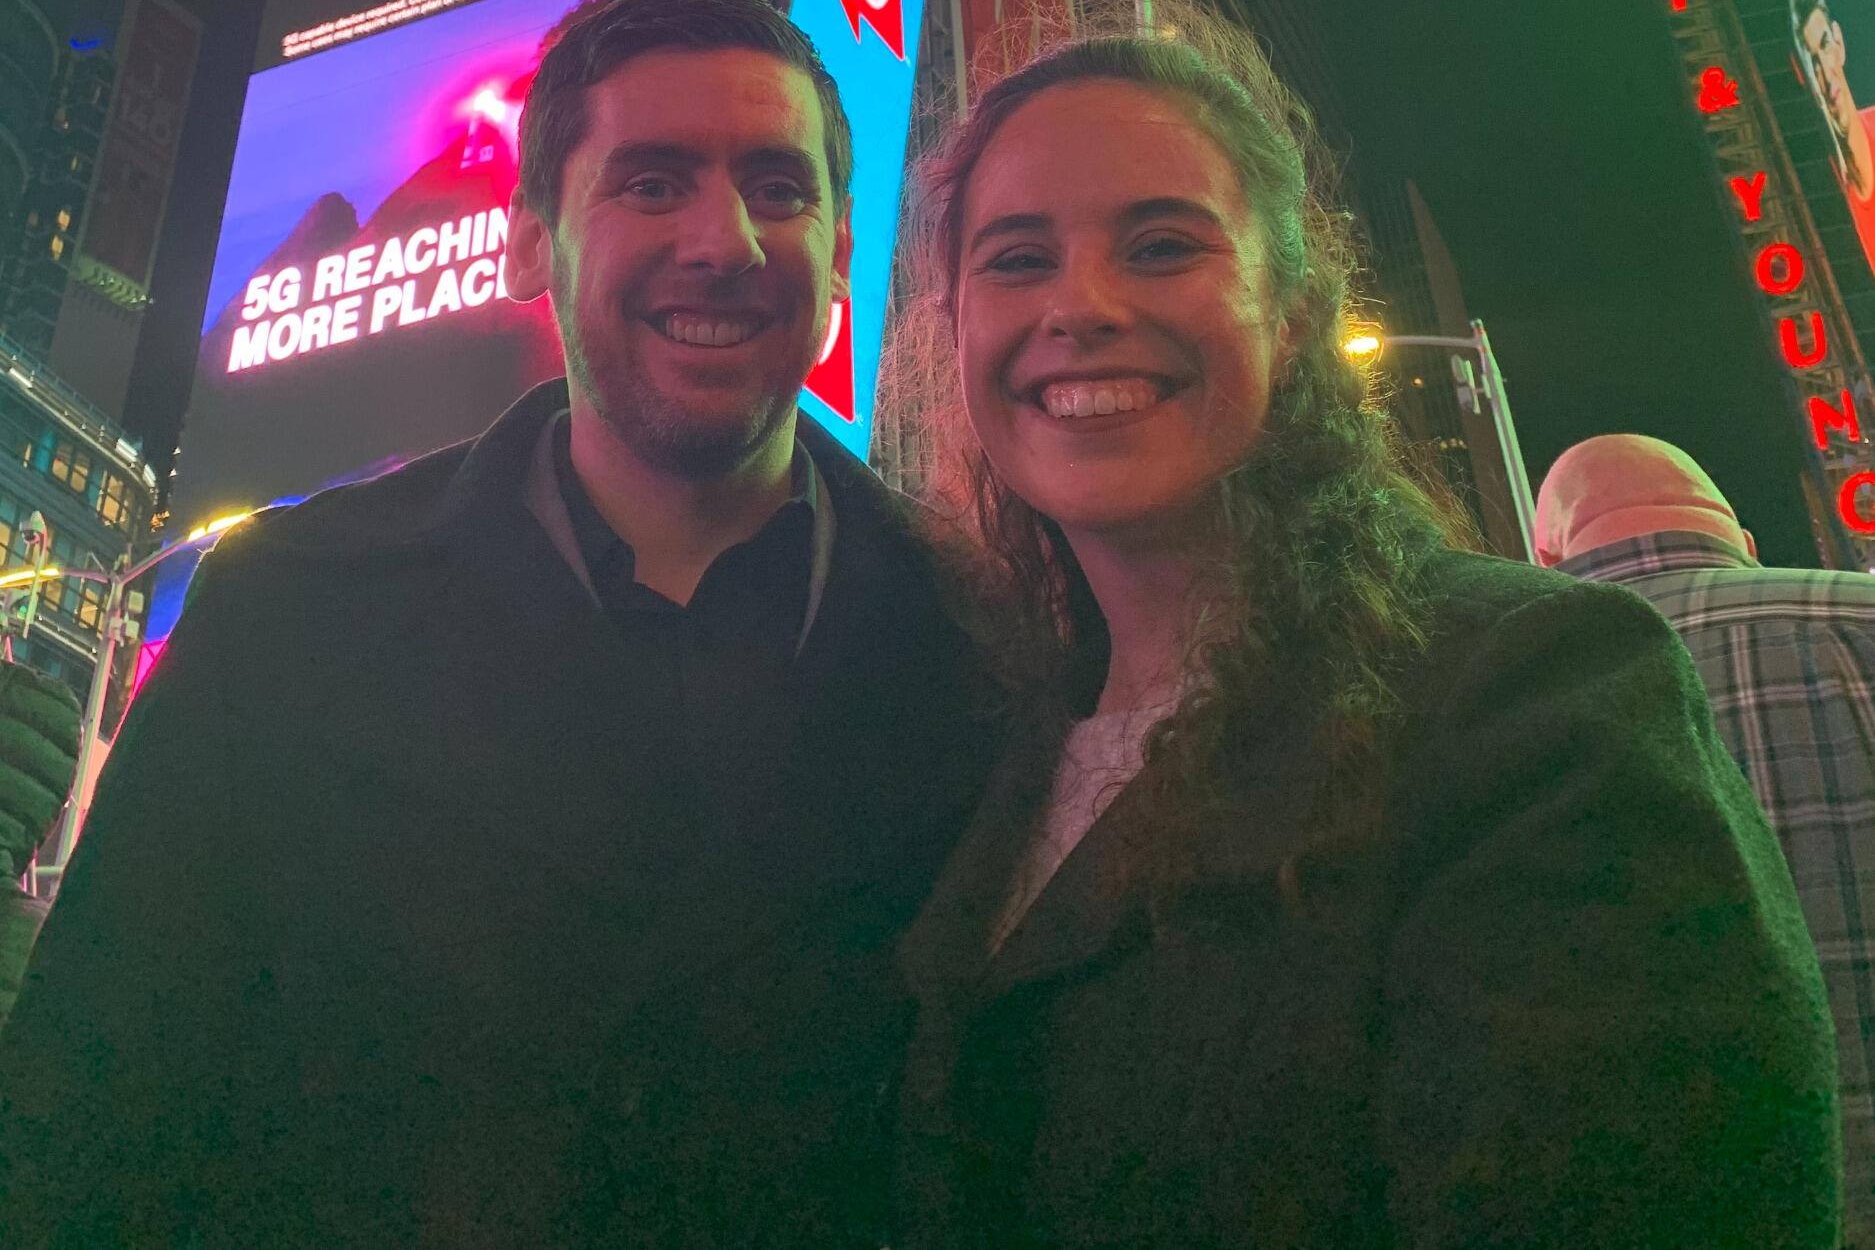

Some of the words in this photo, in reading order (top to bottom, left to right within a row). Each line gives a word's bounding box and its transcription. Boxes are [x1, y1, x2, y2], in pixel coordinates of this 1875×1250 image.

[1698, 65, 1741, 114] &
[226, 295, 362, 373] MORE
[369, 252, 510, 335] PLAC
[241, 266, 302, 322] 5G
[312, 206, 509, 302] REACHIN
